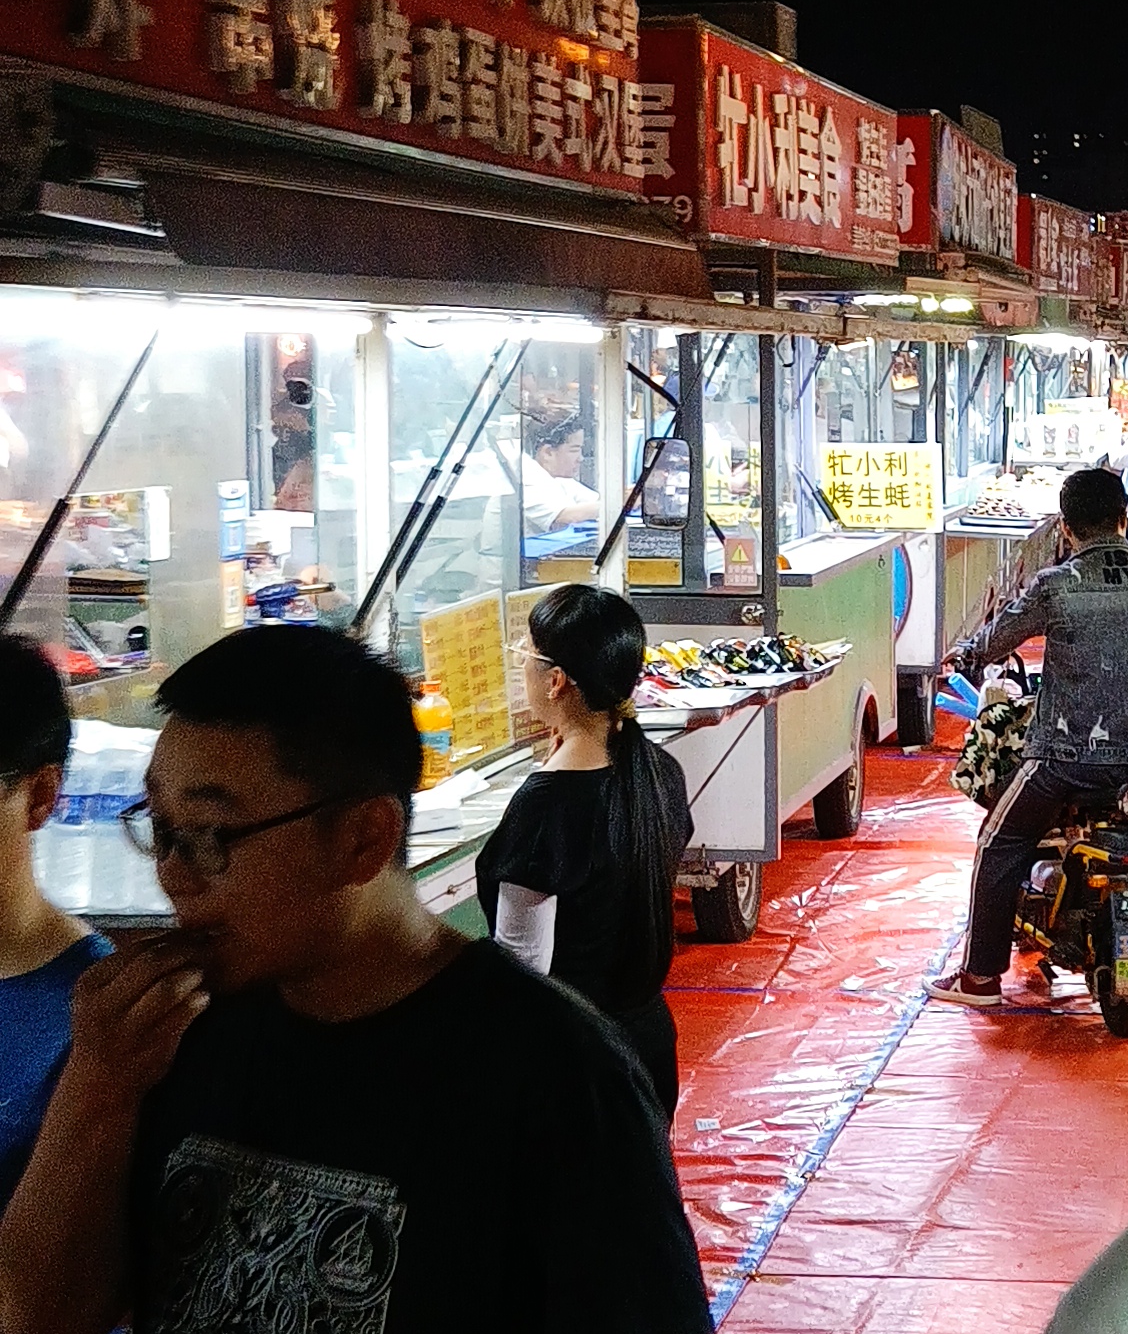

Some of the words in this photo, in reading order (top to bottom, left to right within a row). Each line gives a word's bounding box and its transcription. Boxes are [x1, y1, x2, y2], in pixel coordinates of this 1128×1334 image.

[827, 450, 908, 477] 牤小利
[828, 481, 911, 509] 烤生蚝
[850, 513, 893, 524] 10元4个
